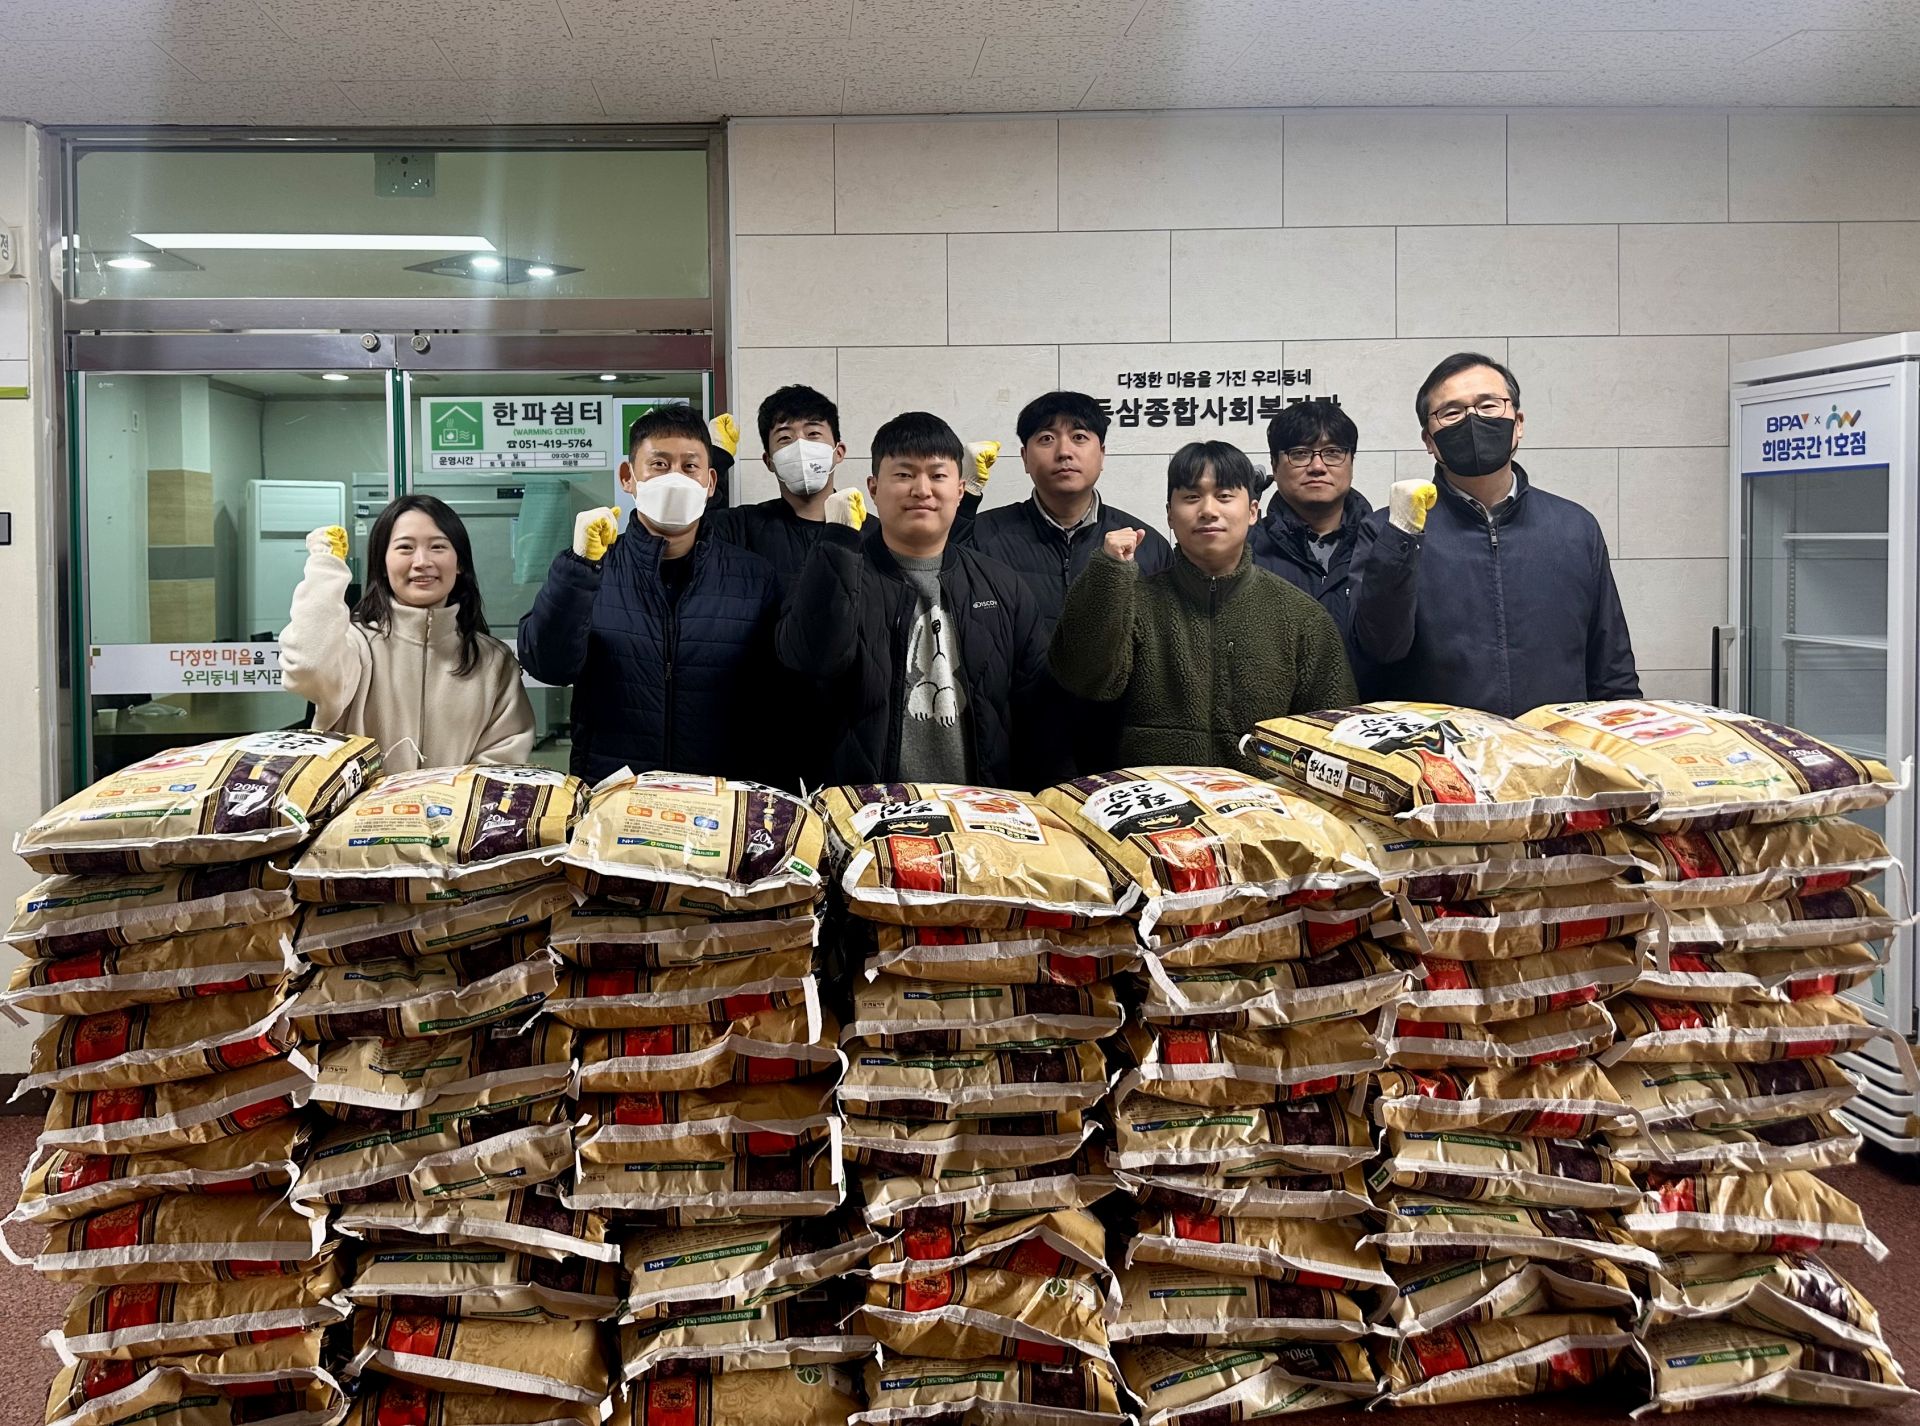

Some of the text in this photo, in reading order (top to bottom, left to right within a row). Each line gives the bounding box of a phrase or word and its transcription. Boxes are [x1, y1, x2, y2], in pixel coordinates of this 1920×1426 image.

[1117, 368, 1311, 389] 다정한 마음을 가진 우리동네
[492, 401, 602, 426] 한파쉼터
[513, 427, 586, 436] (WARMING CENTER)
[1766, 414, 1804, 433] BPA
[519, 439, 592, 448] 051-419-5764
[1762, 430, 1866, 462] 희망곳간 1호점
[439, 456, 474, 466] 운영시간
[170, 649, 218, 666] 다정한
[222, 649, 265, 666] 마음을
[181, 670, 239, 686] 우리동네
[649, 1260, 664, 1269] NH
